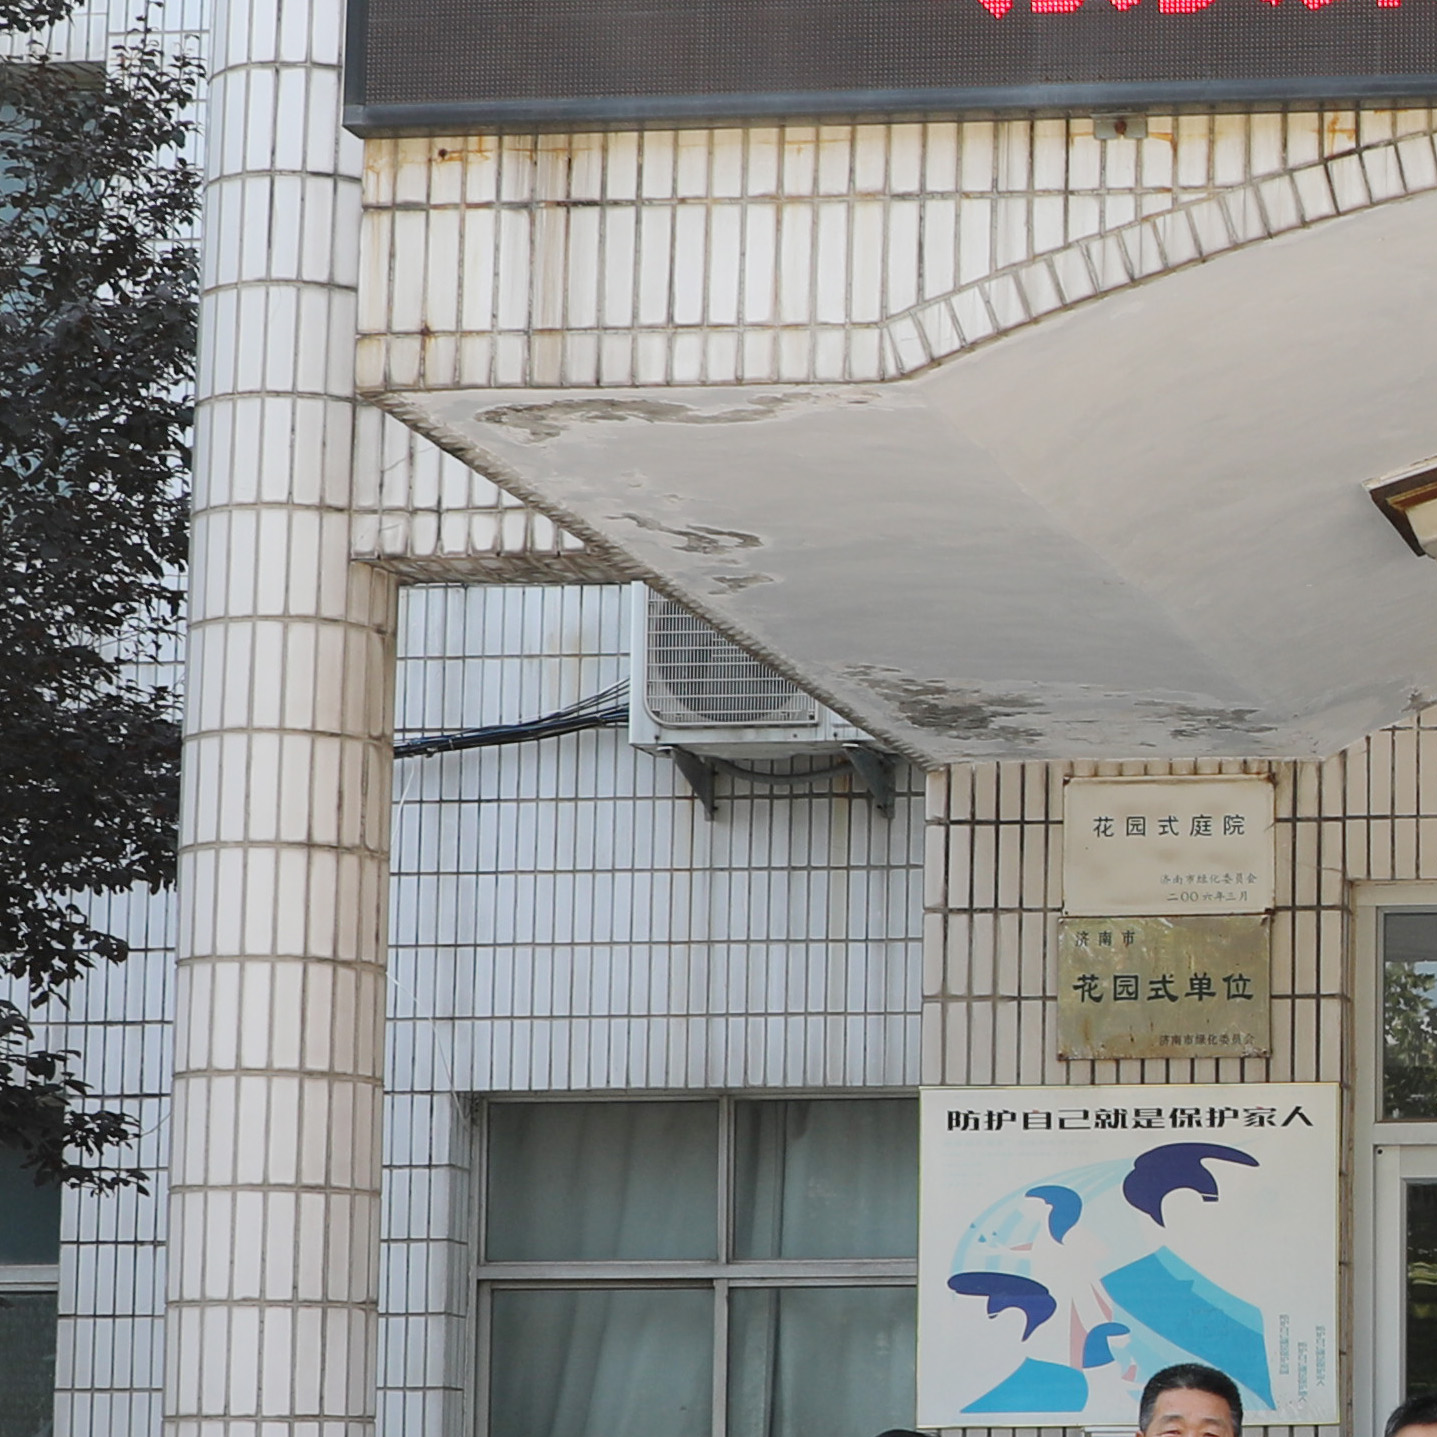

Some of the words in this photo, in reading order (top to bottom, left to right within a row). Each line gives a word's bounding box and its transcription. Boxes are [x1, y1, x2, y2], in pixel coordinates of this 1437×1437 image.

[1092, 813, 1246, 838] 花园式庭院
[1160, 872, 1258, 885] 济南市绿化委员会
[1074, 929, 1136, 948] 济南市
[1072, 972, 1254, 1003] 花园式单位
[1158, 1032, 1256, 1047] 济南市绿化委员会
[946, 1106, 1315, 1132] 防护自己就是保护家人
